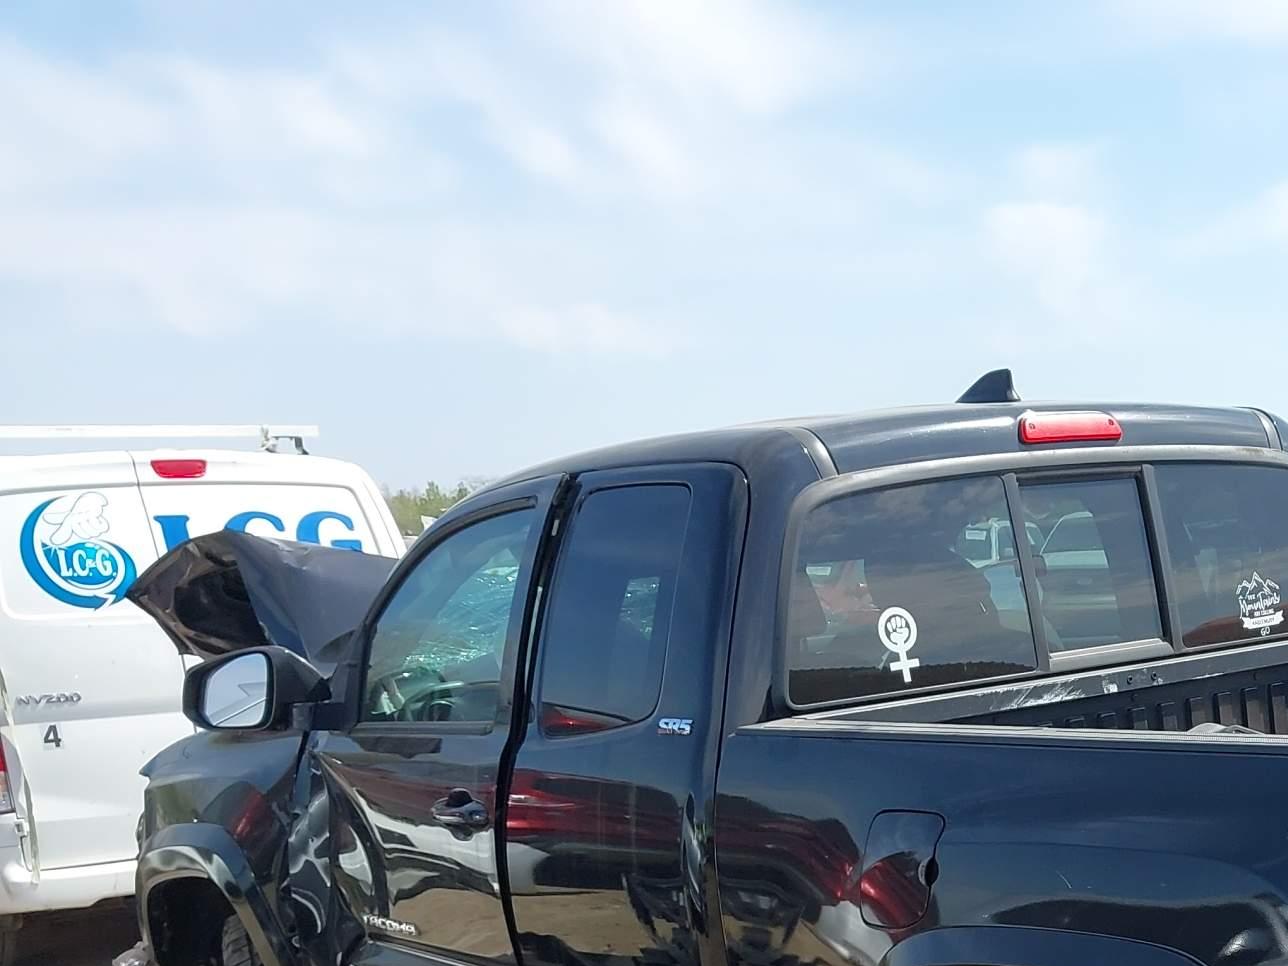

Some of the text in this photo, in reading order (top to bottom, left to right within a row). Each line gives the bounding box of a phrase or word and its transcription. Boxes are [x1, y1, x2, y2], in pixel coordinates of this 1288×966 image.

[1260, 626, 1271, 636] GO
[658, 718, 693, 735] SR5
[43, 724, 62, 748] 4
